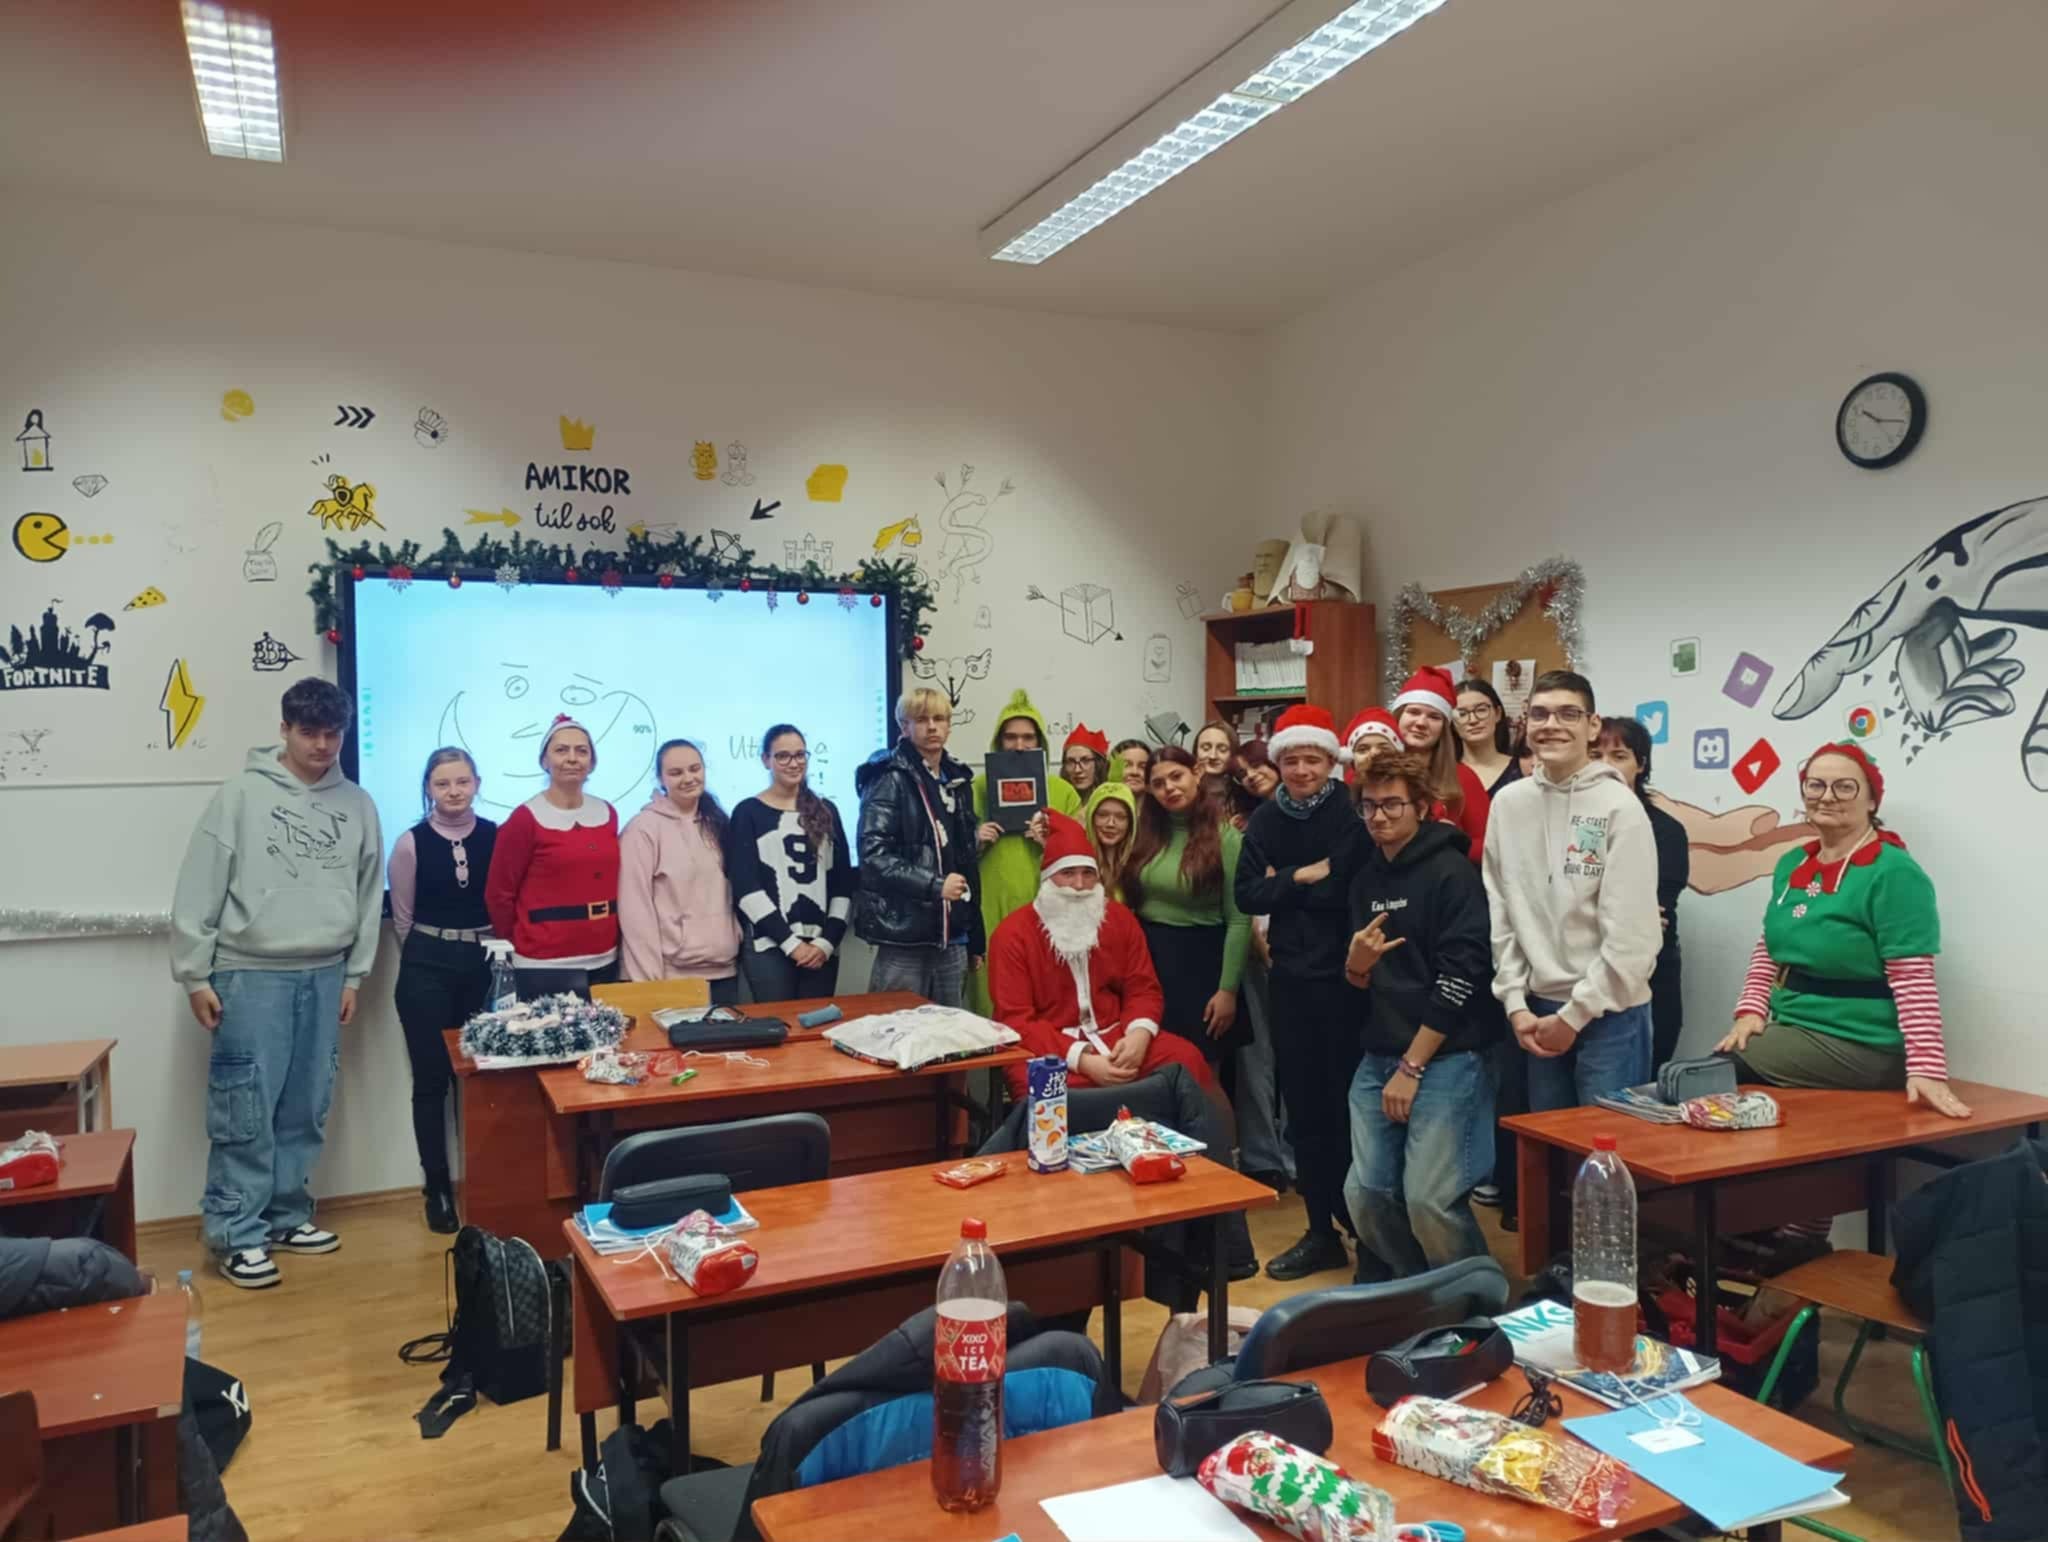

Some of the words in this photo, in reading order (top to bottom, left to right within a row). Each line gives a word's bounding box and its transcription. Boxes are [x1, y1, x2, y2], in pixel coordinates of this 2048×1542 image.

[525, 461, 632, 496] AMIKOR
[533, 501, 574, 530] túl
[575, 504, 617, 534] sok
[2, 665, 99, 689] FORTNITE
[782, 833, 819, 886] 9
[959, 1355, 989, 1371] TEA
[964, 1345, 985, 1355] ICE
